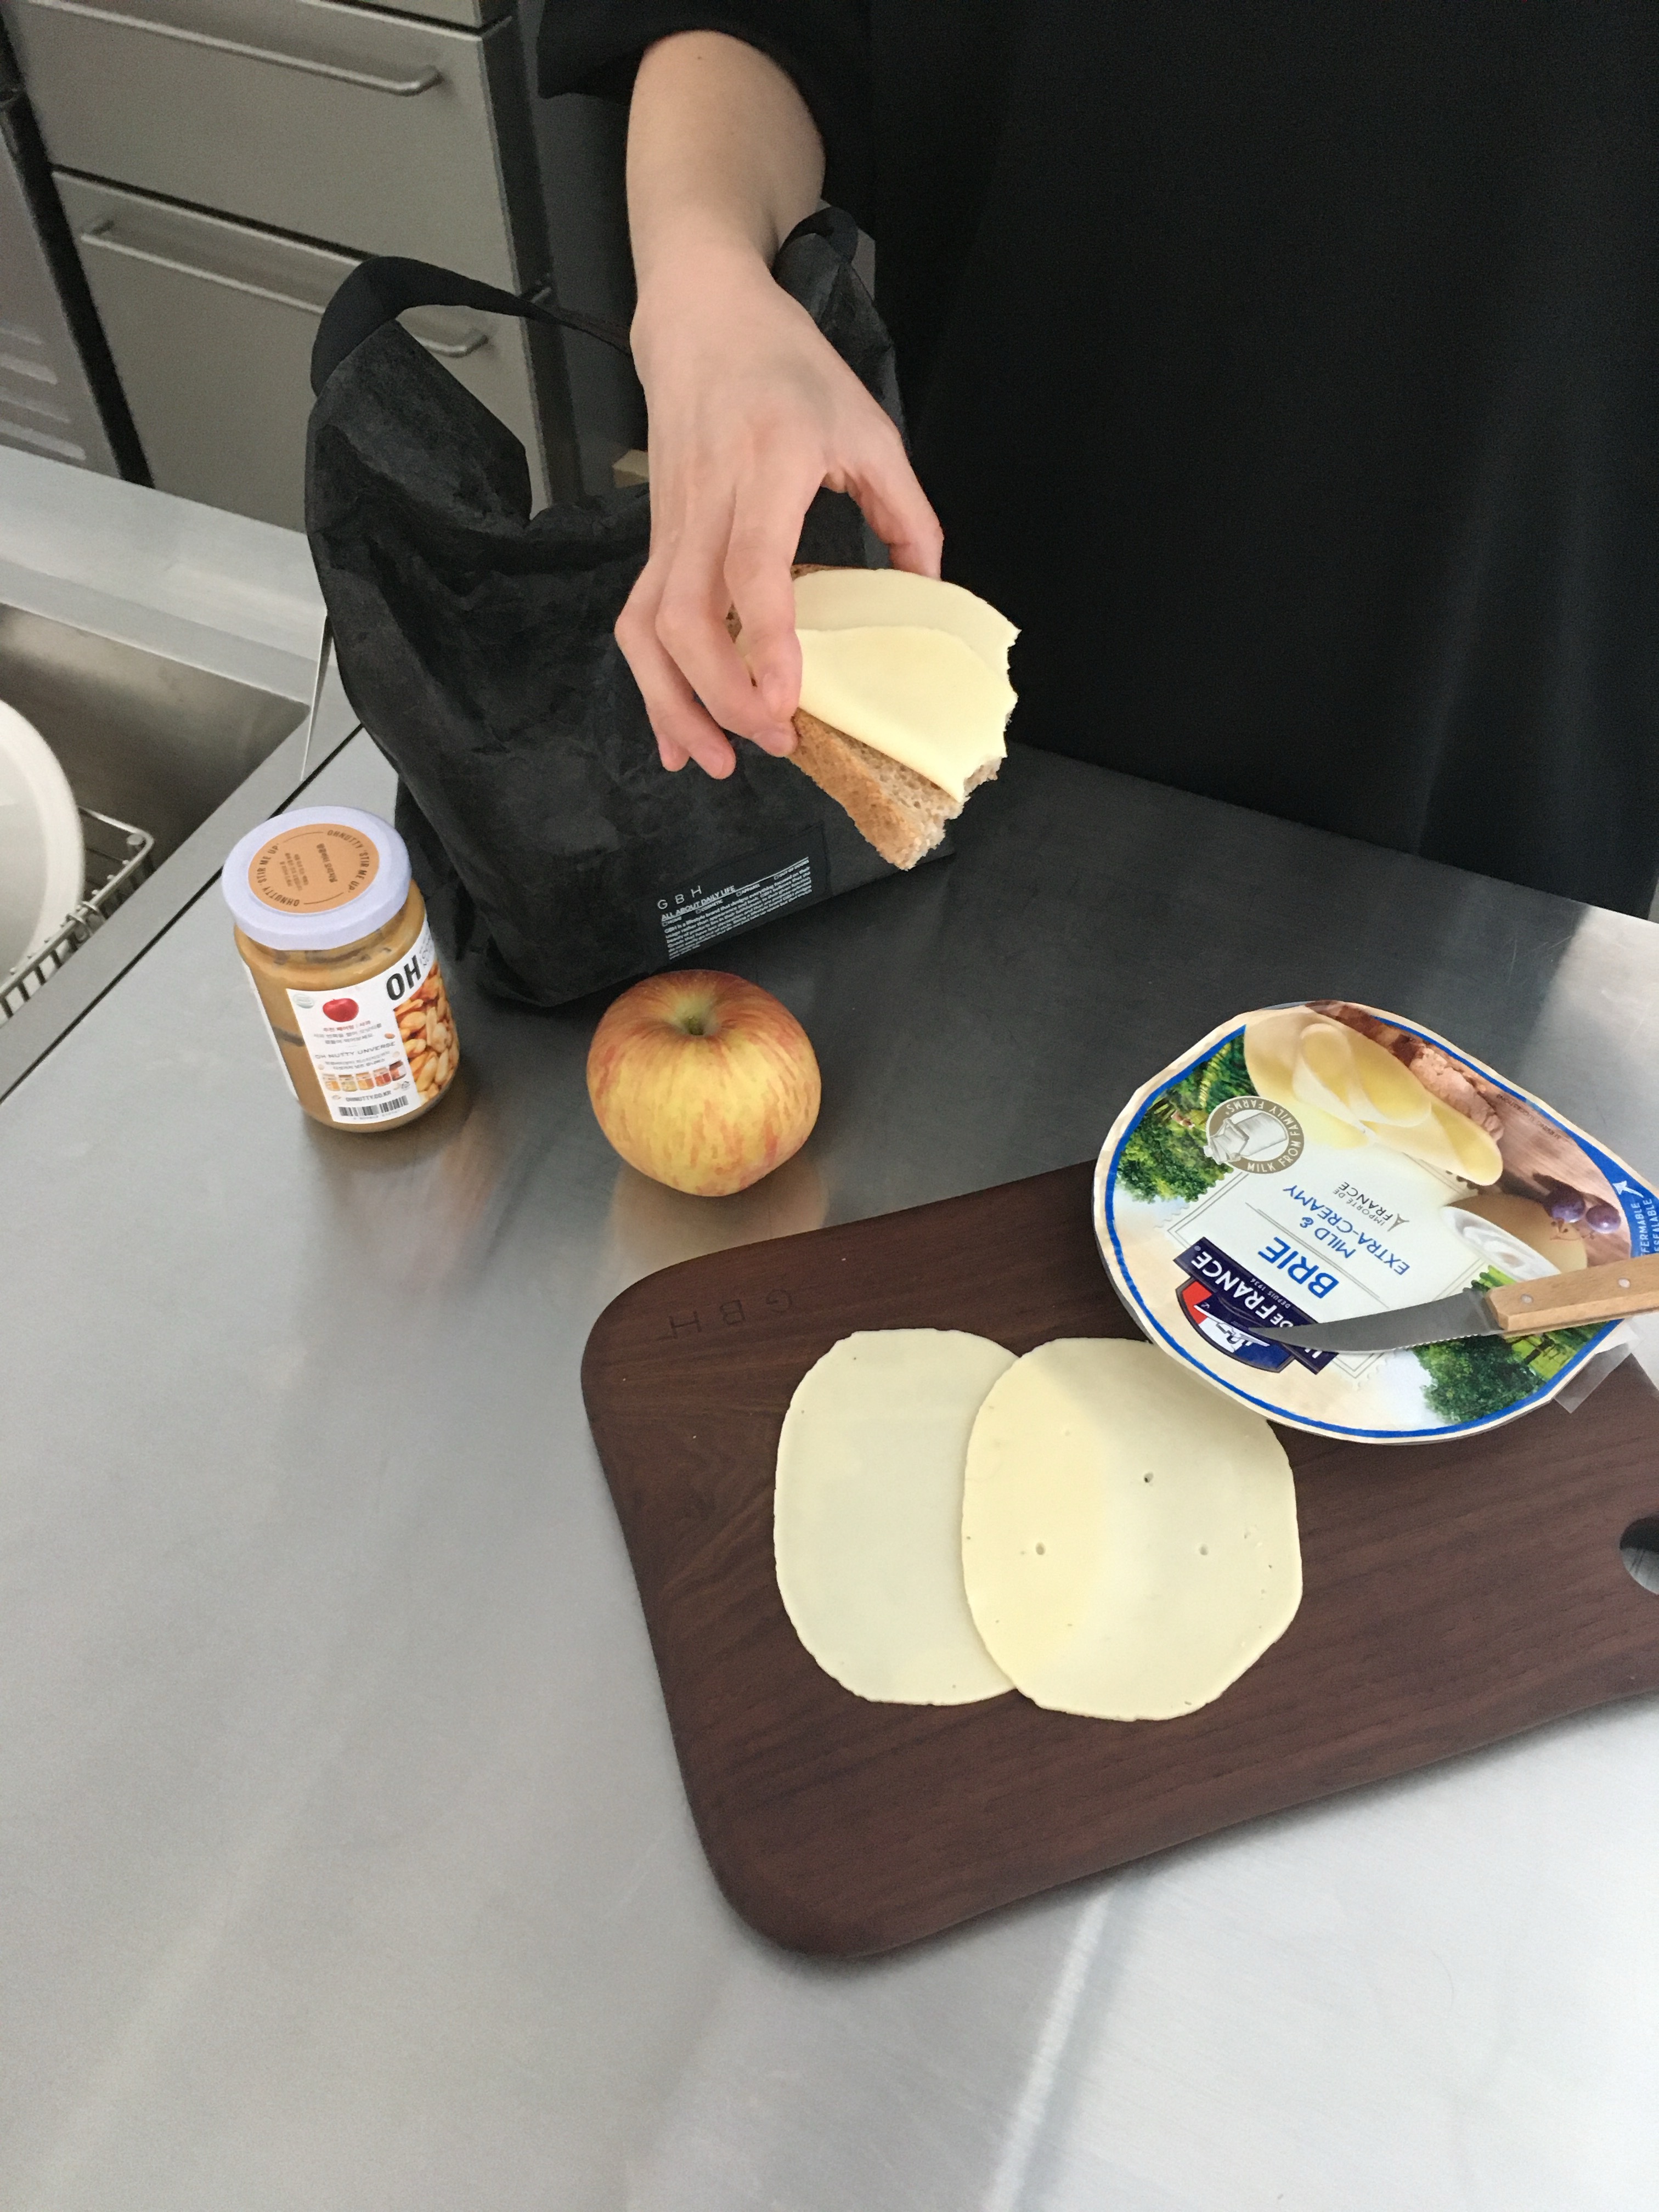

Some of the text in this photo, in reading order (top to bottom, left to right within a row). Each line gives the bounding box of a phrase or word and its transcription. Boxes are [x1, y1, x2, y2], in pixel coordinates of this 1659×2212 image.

[259, 856, 272, 865] ME
[327, 830, 364, 849] OHNUTTY
[356, 870, 367, 880] ME
[262, 886, 300, 906] OHNUTTY
[662, 885, 735, 922] ALL ABOUT DAILY LIFE
[387, 954, 422, 1001] OH
[1269, 1105, 1300, 1136] FAMILY
[1247, 1162, 1276, 1172] MILK
[1278, 1140, 1301, 1166] FROM
[1333, 1188, 1386, 1226] IMPORTÉ DE
[1339, 1181, 1393, 1221] FRANCE
[1283, 1185, 1410, 1276] EXTRA-CREAMY
[1300, 1217, 1356, 1259] MILD &
[1257, 1237, 1340, 1299] BRIE
[1267, 1290, 1291, 1309] DEPUIS
